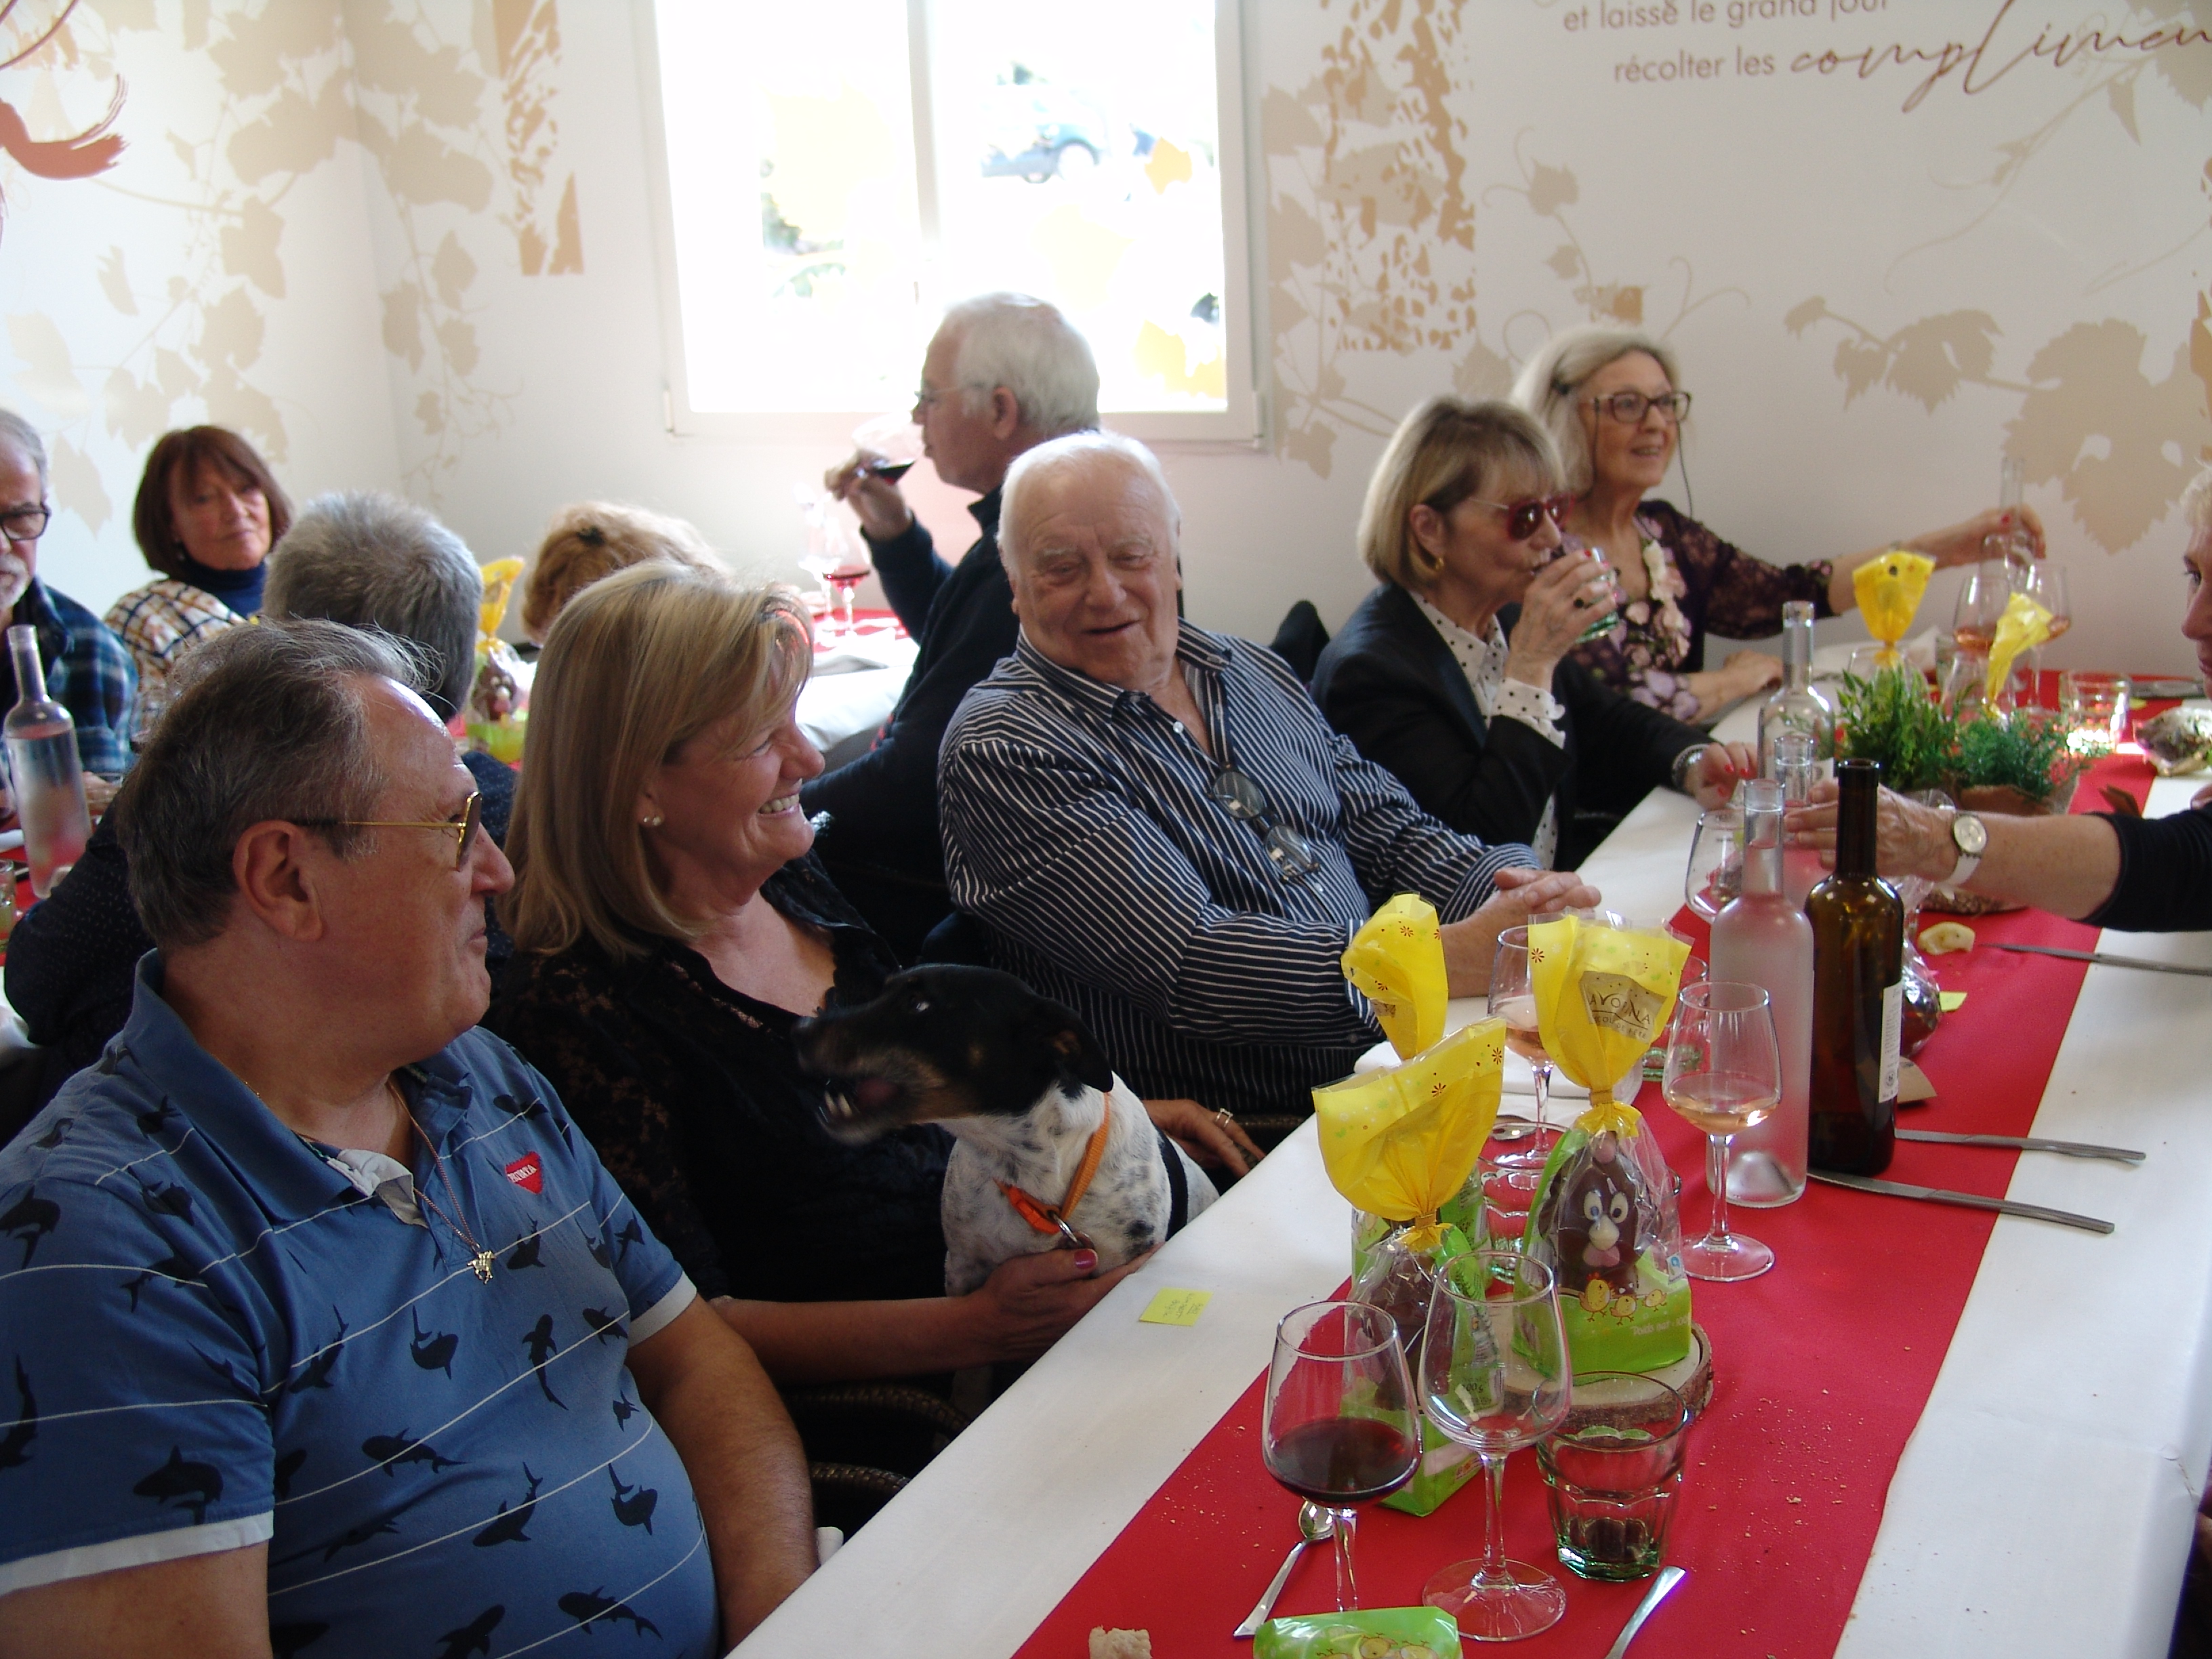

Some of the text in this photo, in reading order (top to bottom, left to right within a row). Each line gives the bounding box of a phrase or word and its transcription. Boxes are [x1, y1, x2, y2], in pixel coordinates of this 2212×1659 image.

[1563, 5, 1589, 31] et
[1690, 0, 1715, 22] le
[1614, 52, 1726, 82] récolter
[1736, 45, 1776, 76] les
